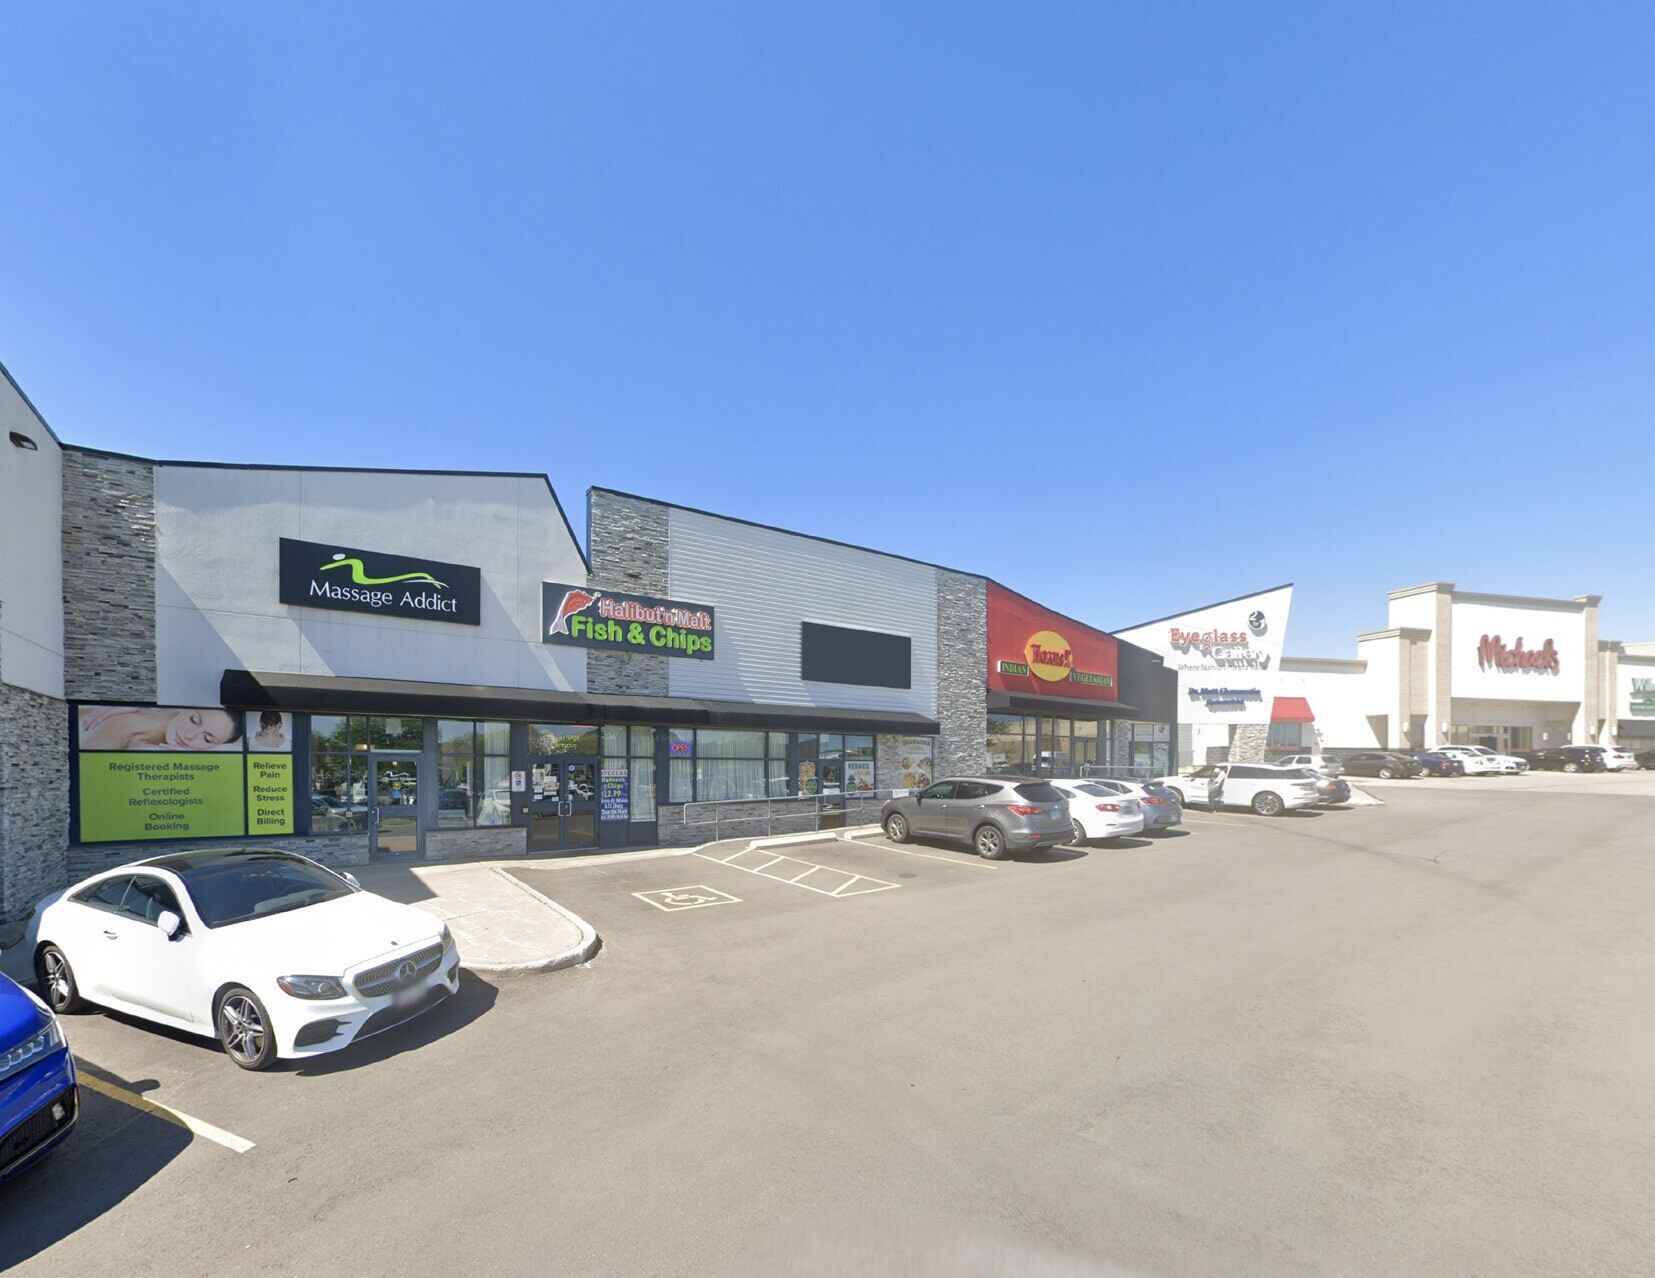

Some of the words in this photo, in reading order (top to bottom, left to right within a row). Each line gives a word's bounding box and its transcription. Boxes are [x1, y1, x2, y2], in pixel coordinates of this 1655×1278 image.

[309, 579, 393, 607] Massage
[399, 591, 458, 612] Addict
[599, 597, 662, 624] Halibut
[676, 608, 712, 631] Malt
[571, 615, 623, 643] Fish
[627, 622, 646, 645] &
[650, 624, 713, 655] Chips
[1170, 627, 1247, 650] Eyeglass
[1477, 634, 1559, 670] Michaels
[1002, 663, 1027, 674] INDIAN
[1178, 663, 1200, 671] Where
[1072, 672, 1111, 685] VEGETARIAN
[671, 743, 689, 752] OPEN
[108, 762, 170, 772] Registered
[173, 762, 220, 772] Massage
[253, 762, 287, 770] Relieve
[137, 772, 195, 781] Therapists
[260, 770, 281, 779] Pain
[142, 787, 190, 796] Certified
[253, 785, 288, 793] Reduce
[129, 797, 204, 807] Reflexologists
[256, 794, 285, 802] Stress
[148, 812, 185, 821] Online
[257, 808, 285, 817] Direct
[256, 817, 286, 826] Billing
[144, 822, 190, 832] Booking
